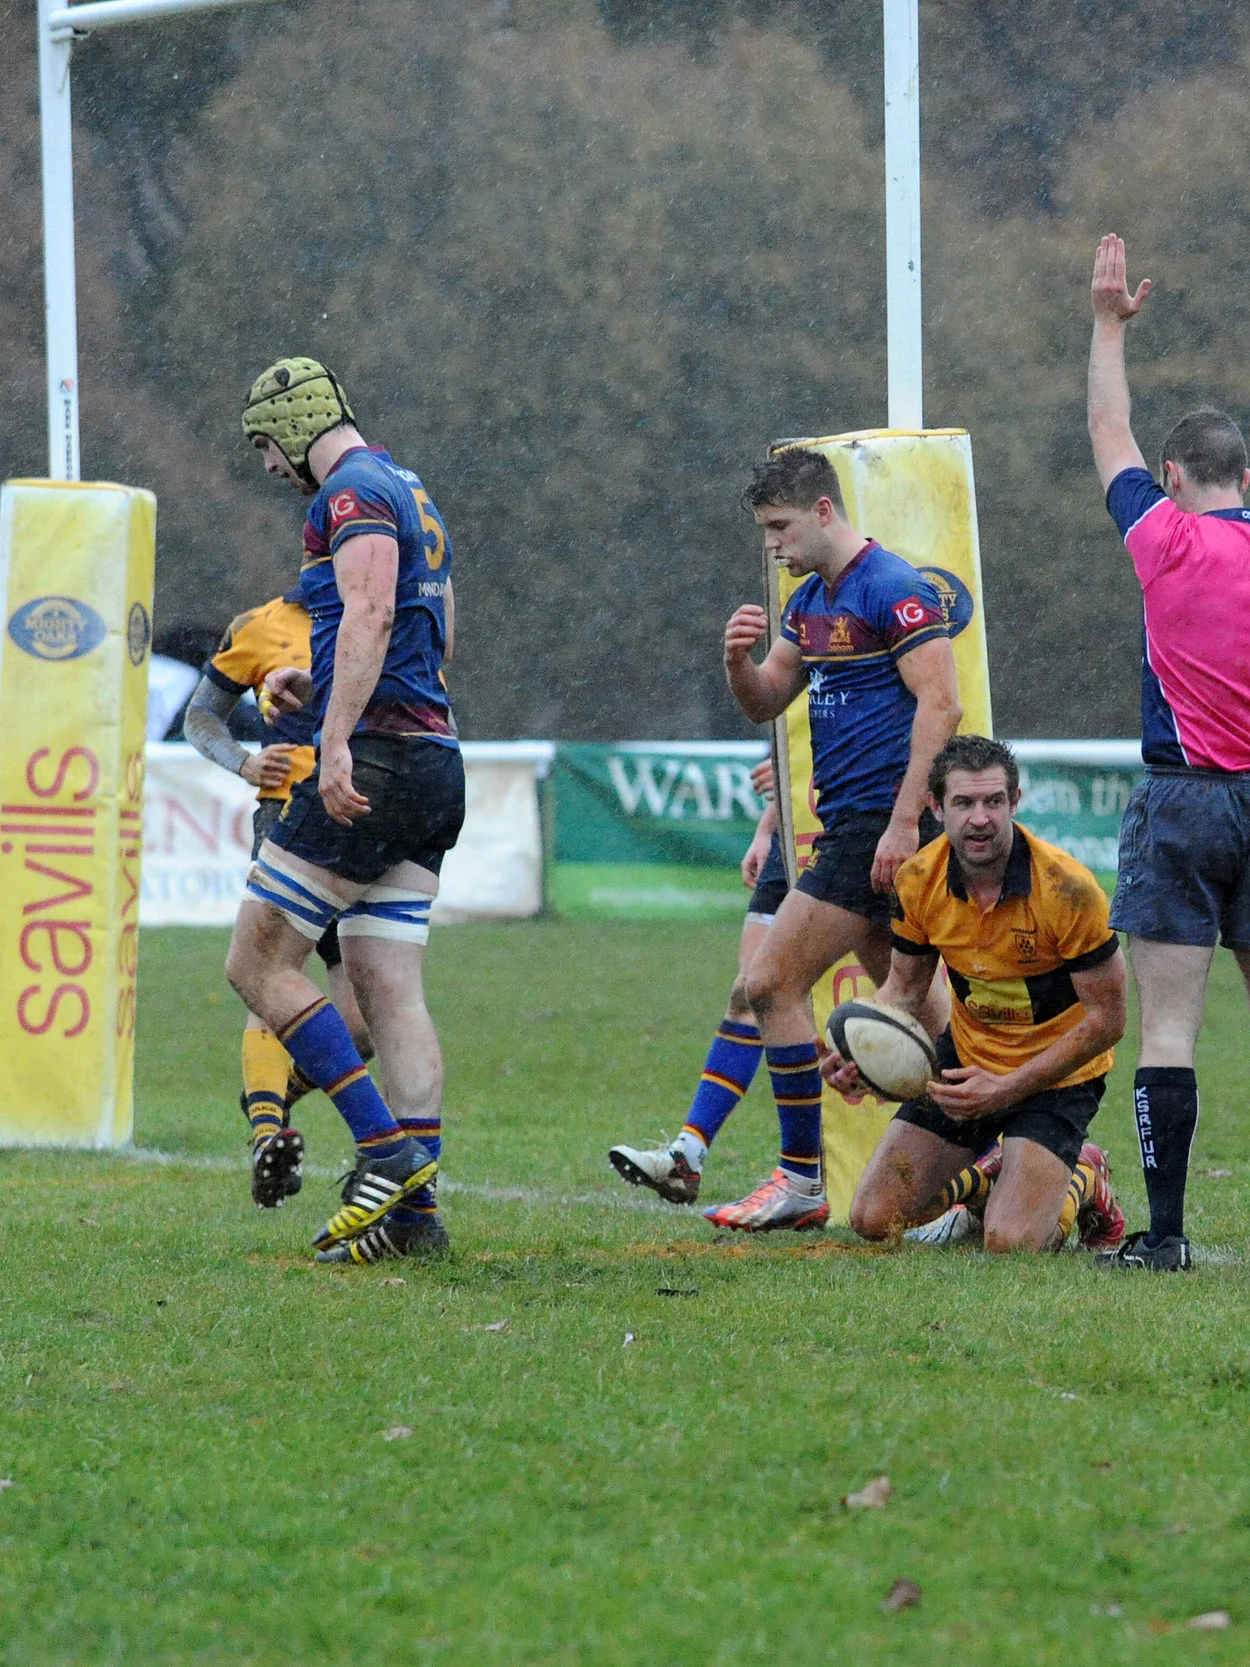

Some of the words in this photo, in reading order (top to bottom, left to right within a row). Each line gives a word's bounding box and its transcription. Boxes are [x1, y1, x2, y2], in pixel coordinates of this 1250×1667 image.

[329, 494, 355, 521] IG
[411, 488, 445, 571] 5
[895, 602, 924, 628] IG
[1, 747, 100, 1039] savills
